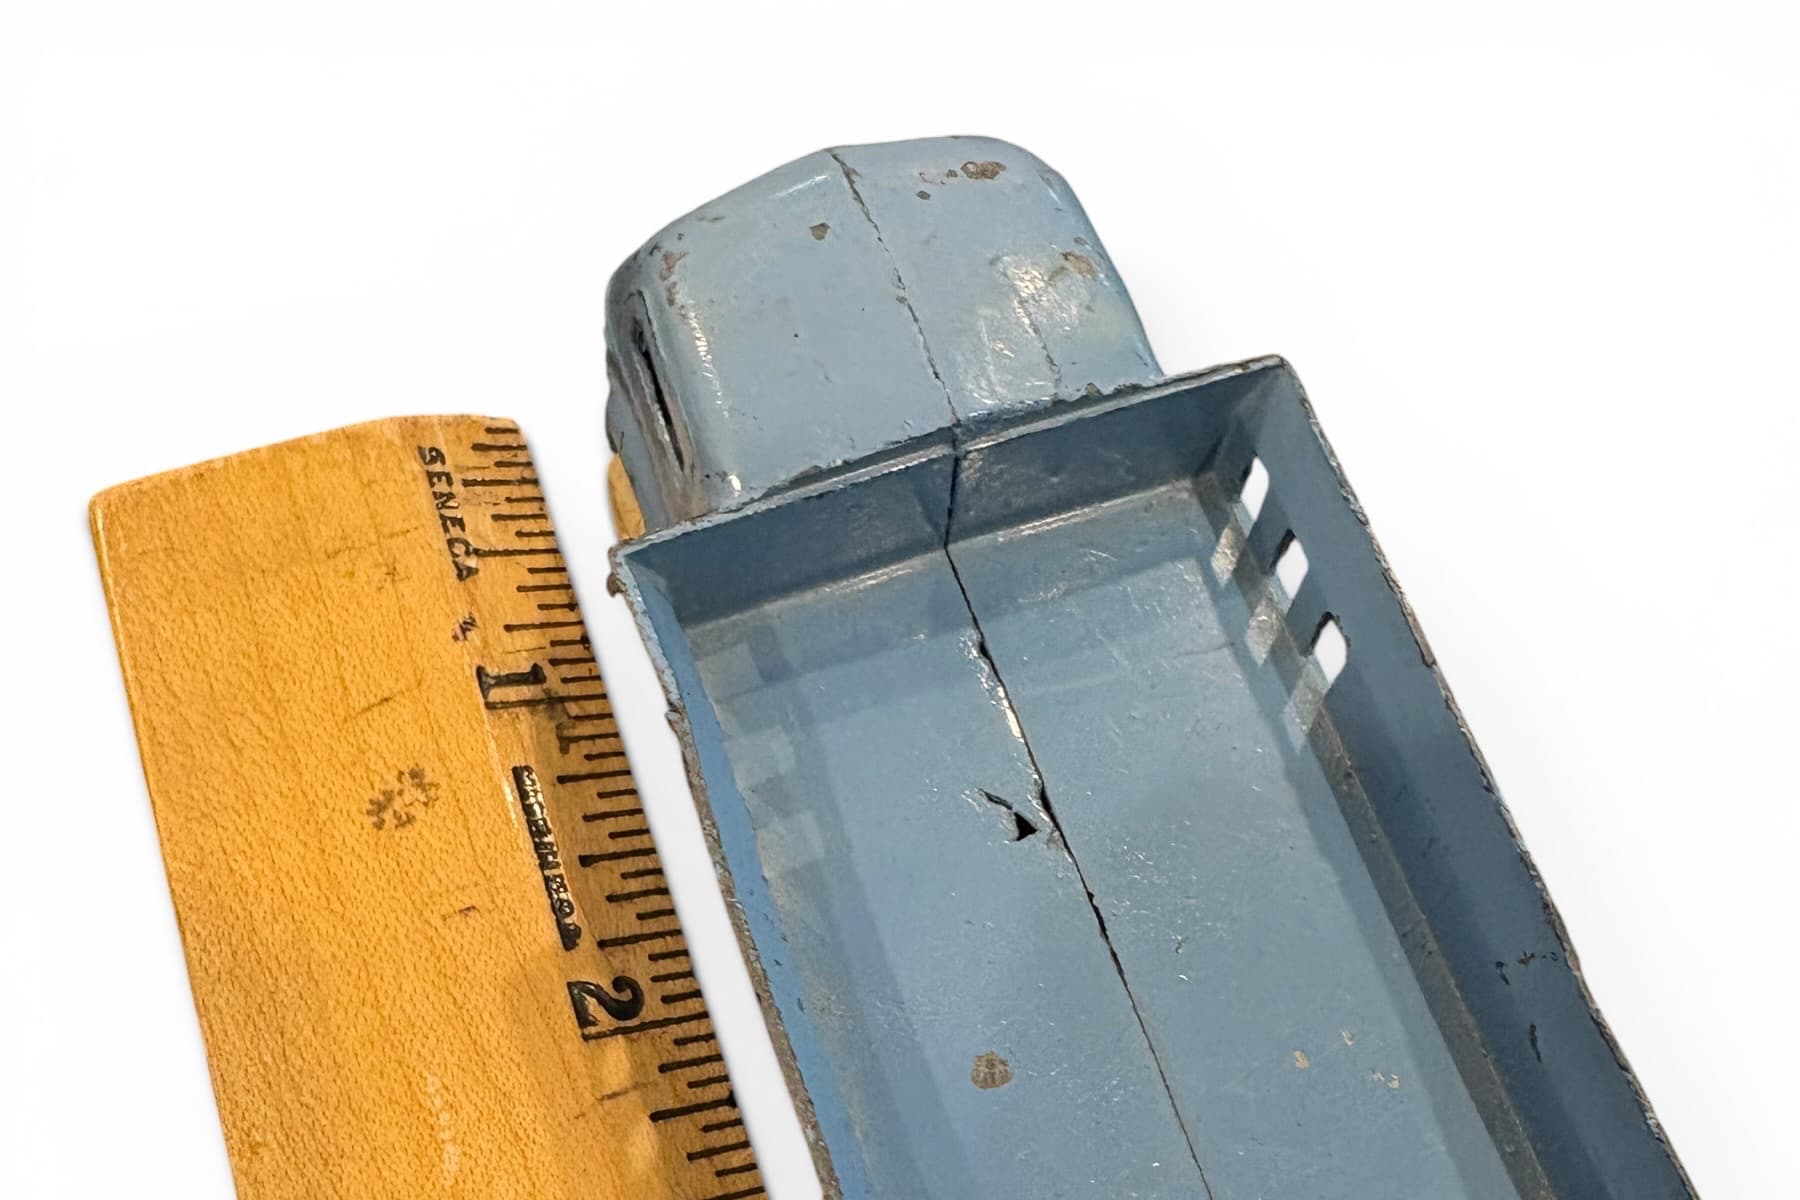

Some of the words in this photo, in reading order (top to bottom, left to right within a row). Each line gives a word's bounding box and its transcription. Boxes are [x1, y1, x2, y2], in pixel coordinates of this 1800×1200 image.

[417, 445, 479, 582] SENECA
[476, 662, 547, 700] 1
[566, 975, 644, 1029] 2
